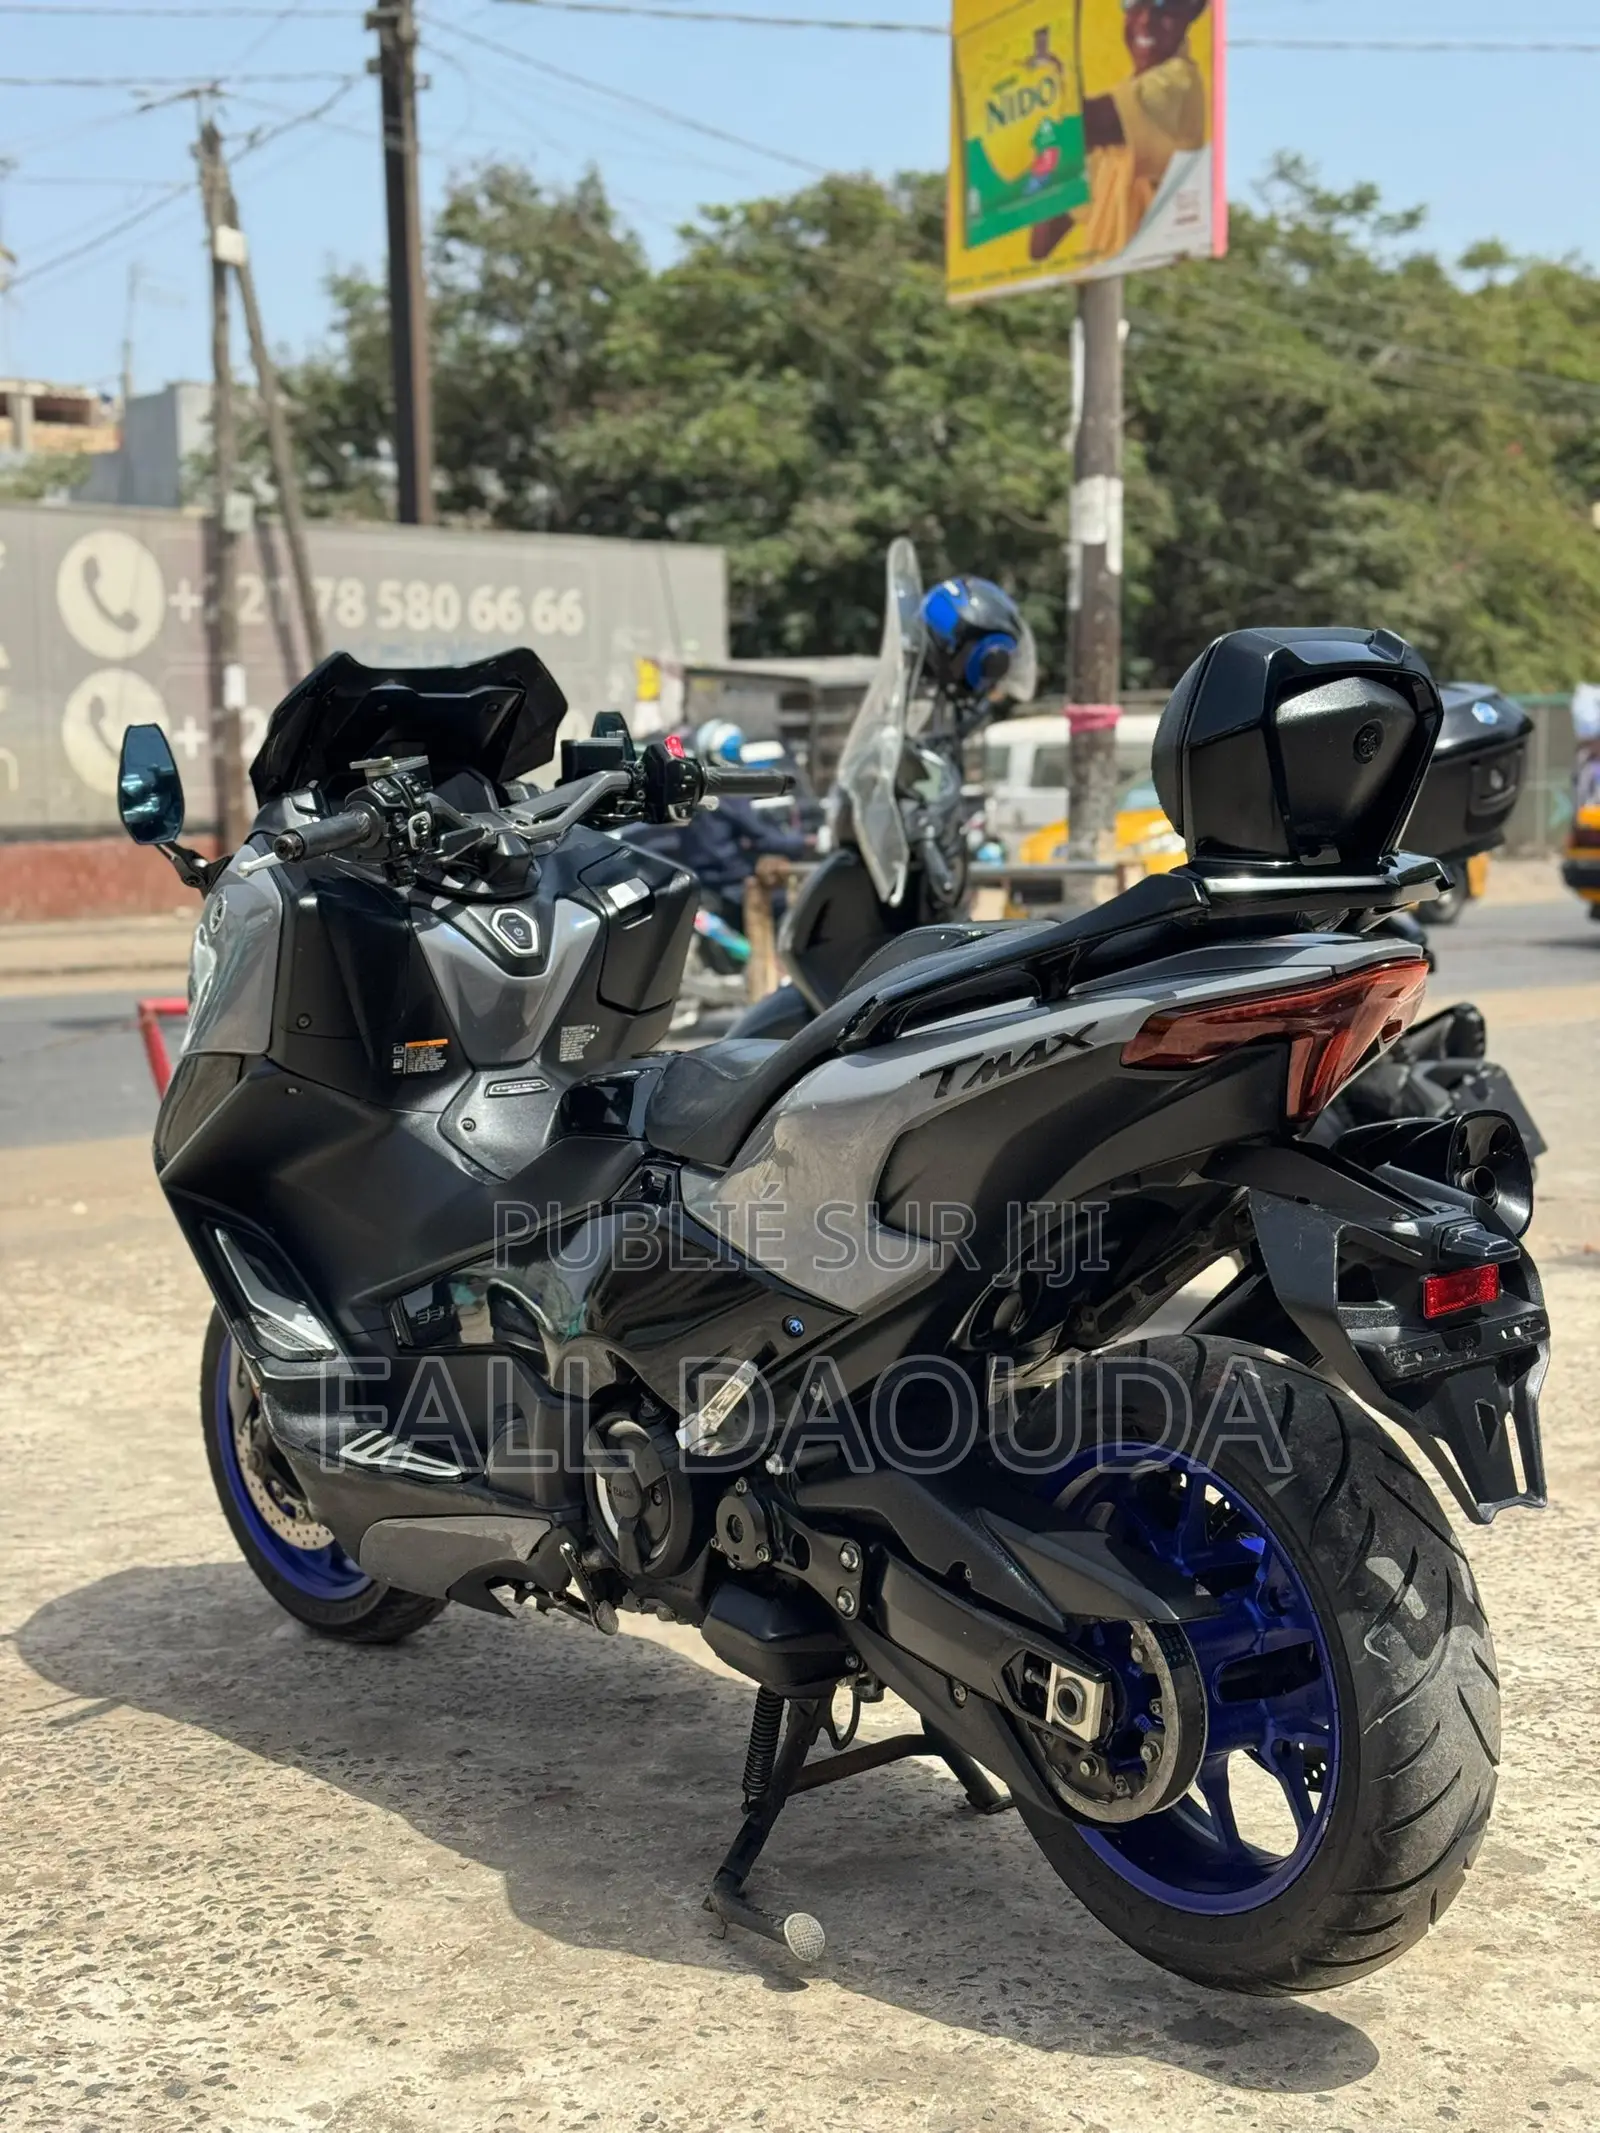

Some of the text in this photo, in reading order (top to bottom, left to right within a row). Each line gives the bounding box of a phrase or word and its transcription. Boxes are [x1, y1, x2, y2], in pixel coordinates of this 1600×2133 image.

[986, 77, 1058, 132] NIDO
[376, 580, 461, 632] 580
[468, 585, 524, 634] 66
[531, 588, 585, 637] 66
[918, 1021, 1099, 1099] TMAX
